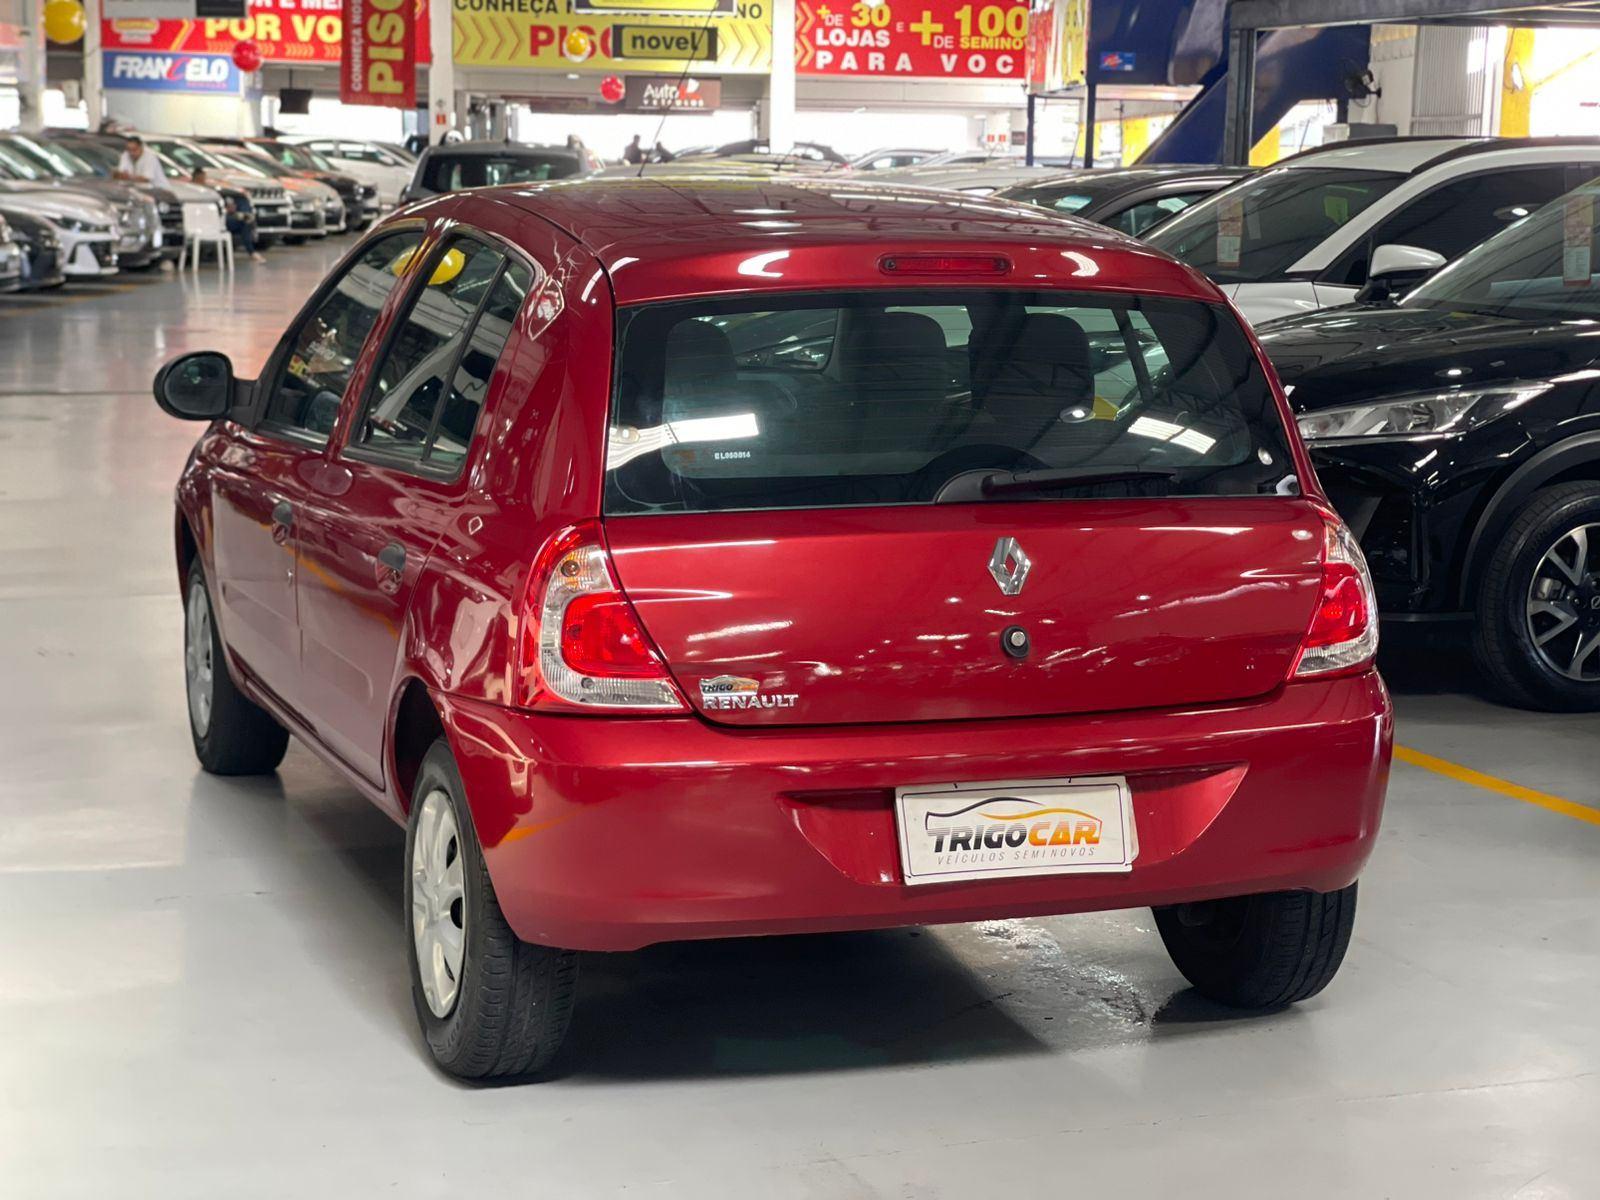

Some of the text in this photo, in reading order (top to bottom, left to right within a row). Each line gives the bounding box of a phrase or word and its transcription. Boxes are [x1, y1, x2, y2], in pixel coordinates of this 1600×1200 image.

[454, 0, 558, 17] CONHEÇA
[824, 14, 844, 27] DE
[850, 2, 891, 28] 30
[205, 13, 282, 41] POR
[631, 31, 699, 51] novel
[815, 27, 891, 48] LOJAS
[932, 35, 954, 49] DE
[815, 50, 913, 71] PARA
[702, 694, 799, 710] RENAULT
[927, 820, 1101, 853] TRIGOCAR
[937, 846, 1096, 866] VEÍCULOS SEMINOVOS
